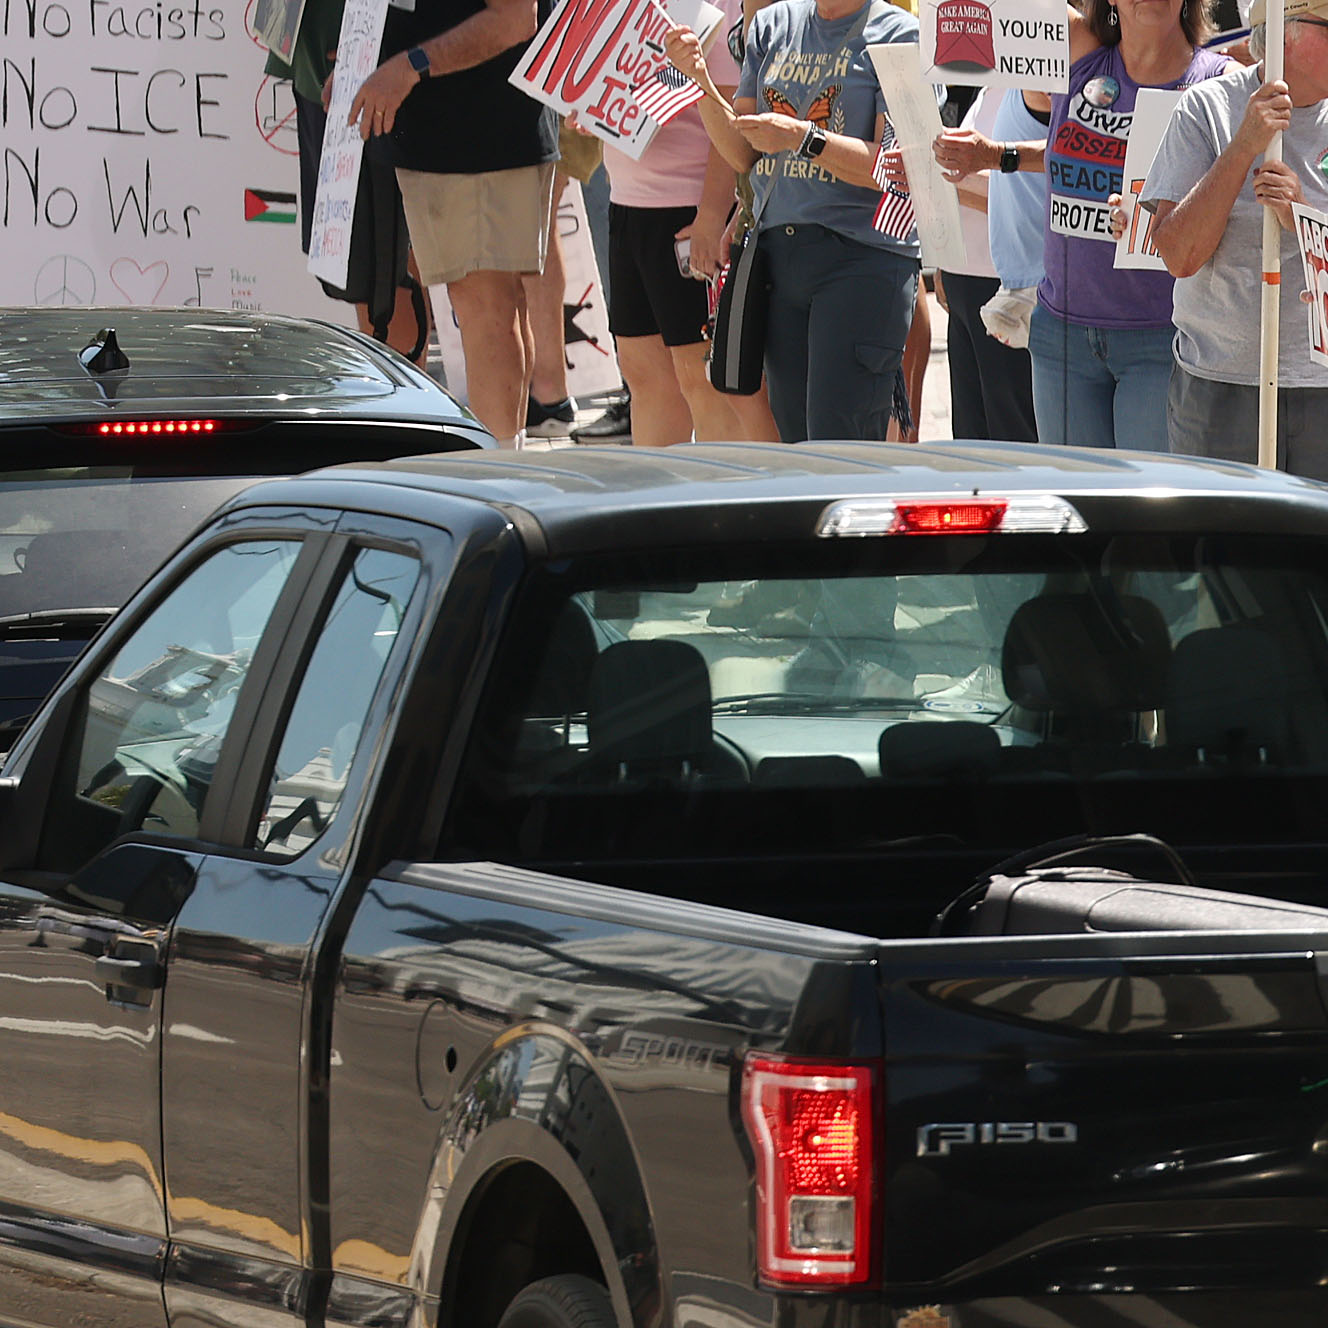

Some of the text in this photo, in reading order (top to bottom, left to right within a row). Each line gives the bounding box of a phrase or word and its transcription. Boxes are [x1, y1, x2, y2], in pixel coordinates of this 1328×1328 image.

[999, 19, 1064, 43] YOU'RE
[1000, 54, 1066, 78] NEXT!!!
[1, 58, 231, 139] No ICE
[4, 147, 199, 239] No War
